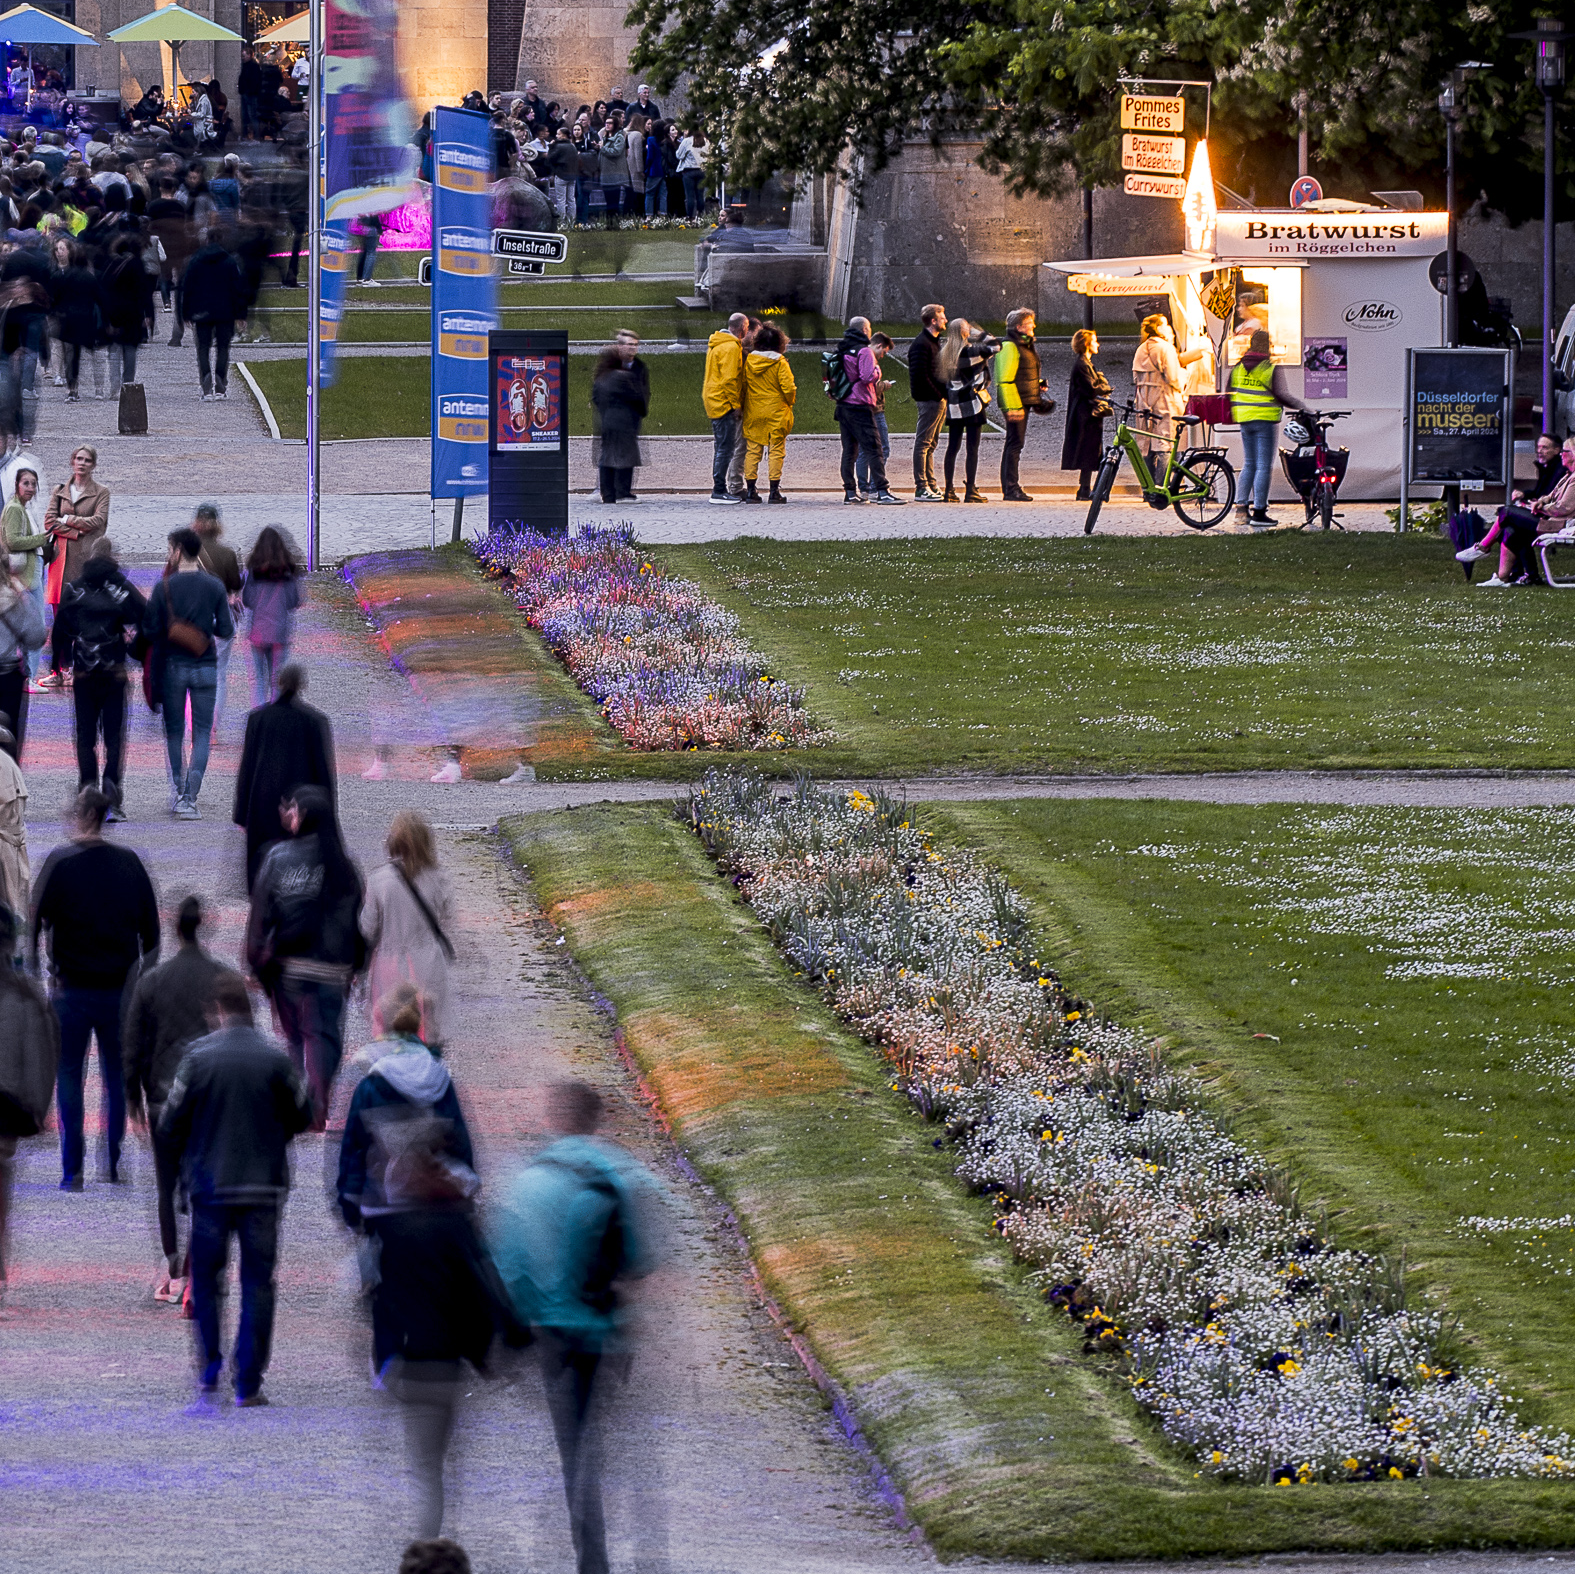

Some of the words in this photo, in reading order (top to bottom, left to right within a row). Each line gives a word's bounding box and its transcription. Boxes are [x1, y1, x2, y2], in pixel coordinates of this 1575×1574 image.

[1125, 97, 1181, 114] Pommes
[1134, 113, 1172, 129] Frites
[1132, 136, 1174, 155] Bratwurst
[1124, 152, 1135, 167] im
[1136, 153, 1183, 172] Röggelchen
[1126, 177, 1184, 196] Currywurst
[1245, 221, 1421, 240] Bratwurst
[503, 238, 556, 256] Inselstraße
[1269, 242, 1291, 253] im
[1296, 242, 1397, 255] Röggelchen
[1093, 282, 1166, 295] Currywurst
[1417, 391, 1499, 403] Düsseldorfer
[443, 400, 489, 415] antenn
[1417, 402, 1452, 413] nacht
[1455, 402, 1476, 413] der
[1417, 413, 1499, 428] museen
[1461, 428, 1480, 436] April
